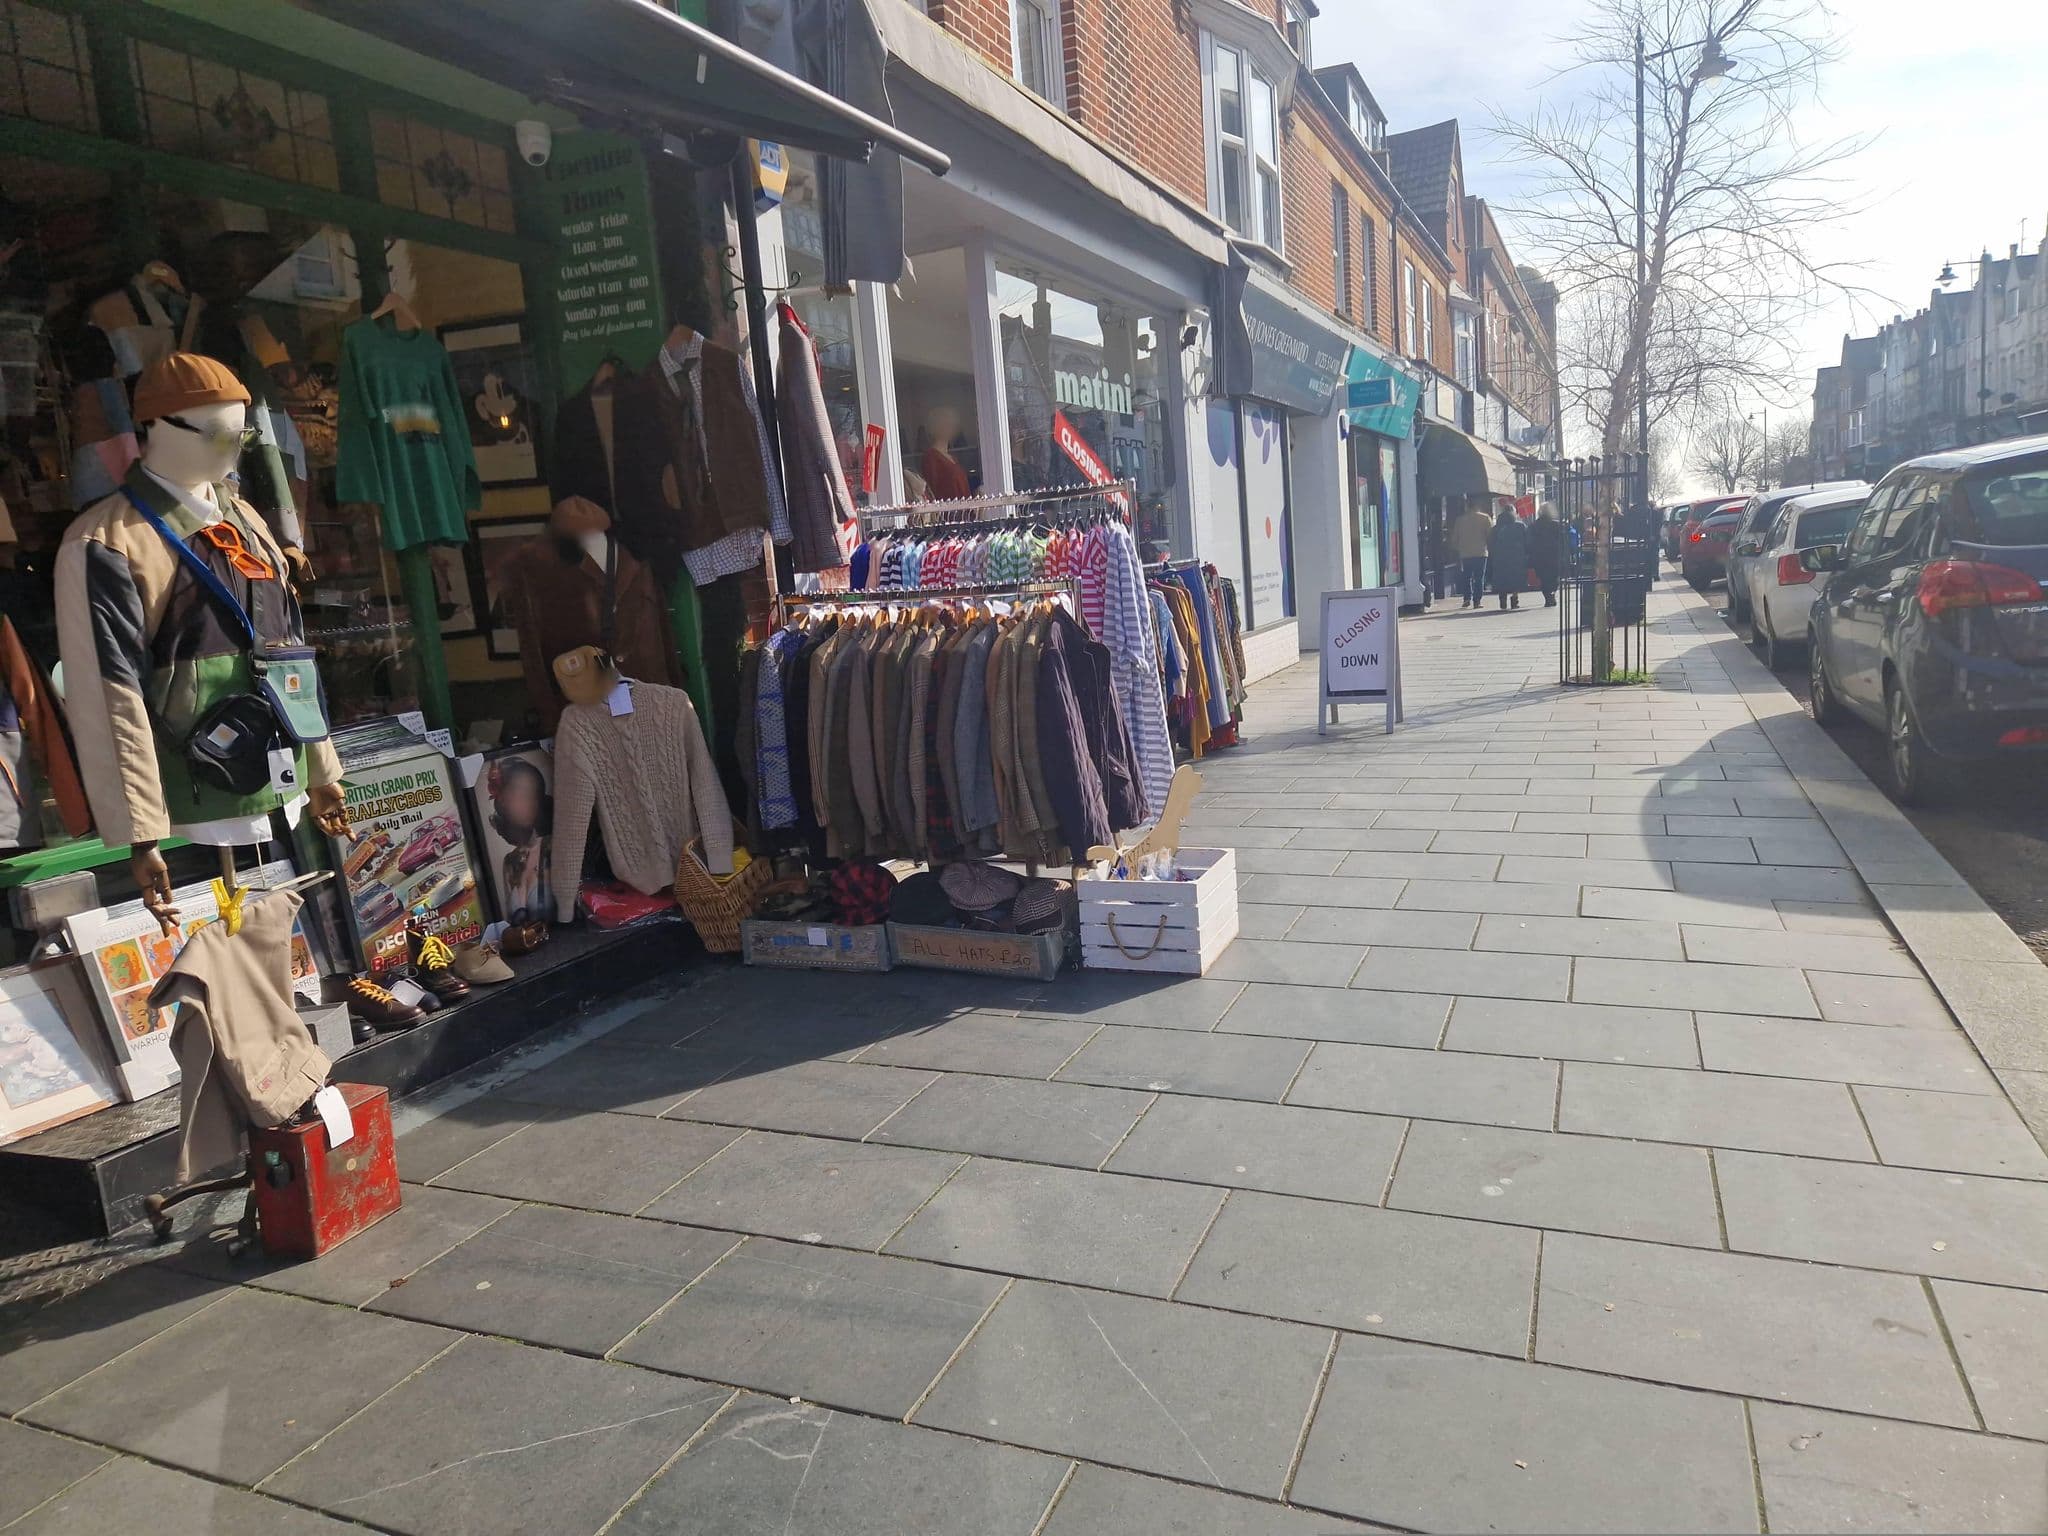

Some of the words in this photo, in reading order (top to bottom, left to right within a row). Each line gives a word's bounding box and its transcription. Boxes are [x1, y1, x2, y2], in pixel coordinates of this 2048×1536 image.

[760, 143, 781, 168] ADT
[600, 212, 630, 230] Friday
[561, 260, 590, 281] Closed
[590, 254, 638, 276] Wednesday
[557, 284, 596, 302] Saturday
[598, 278, 622, 295] 11am
[565, 306, 597, 324] Sunday
[1253, 319, 1278, 350] JONES
[1274, 328, 1310, 364] GREENWOOD
[1055, 367, 1134, 415] matini
[1061, 428, 1102, 486] CLOSING
[1334, 607, 1381, 649] CLOSING
[1341, 653, 1379, 668] DOWN
[382, 774, 414, 798] GRAND
[416, 769, 439, 789] PRIX
[345, 785, 443, 824] RALLYCROSS
[401, 810, 423, 826] Mail
[449, 906, 470, 928] 8/9
[913, 936, 950, 957] ALL
[958, 945, 996, 963] HATS
[997, 948, 1032, 967] £20
